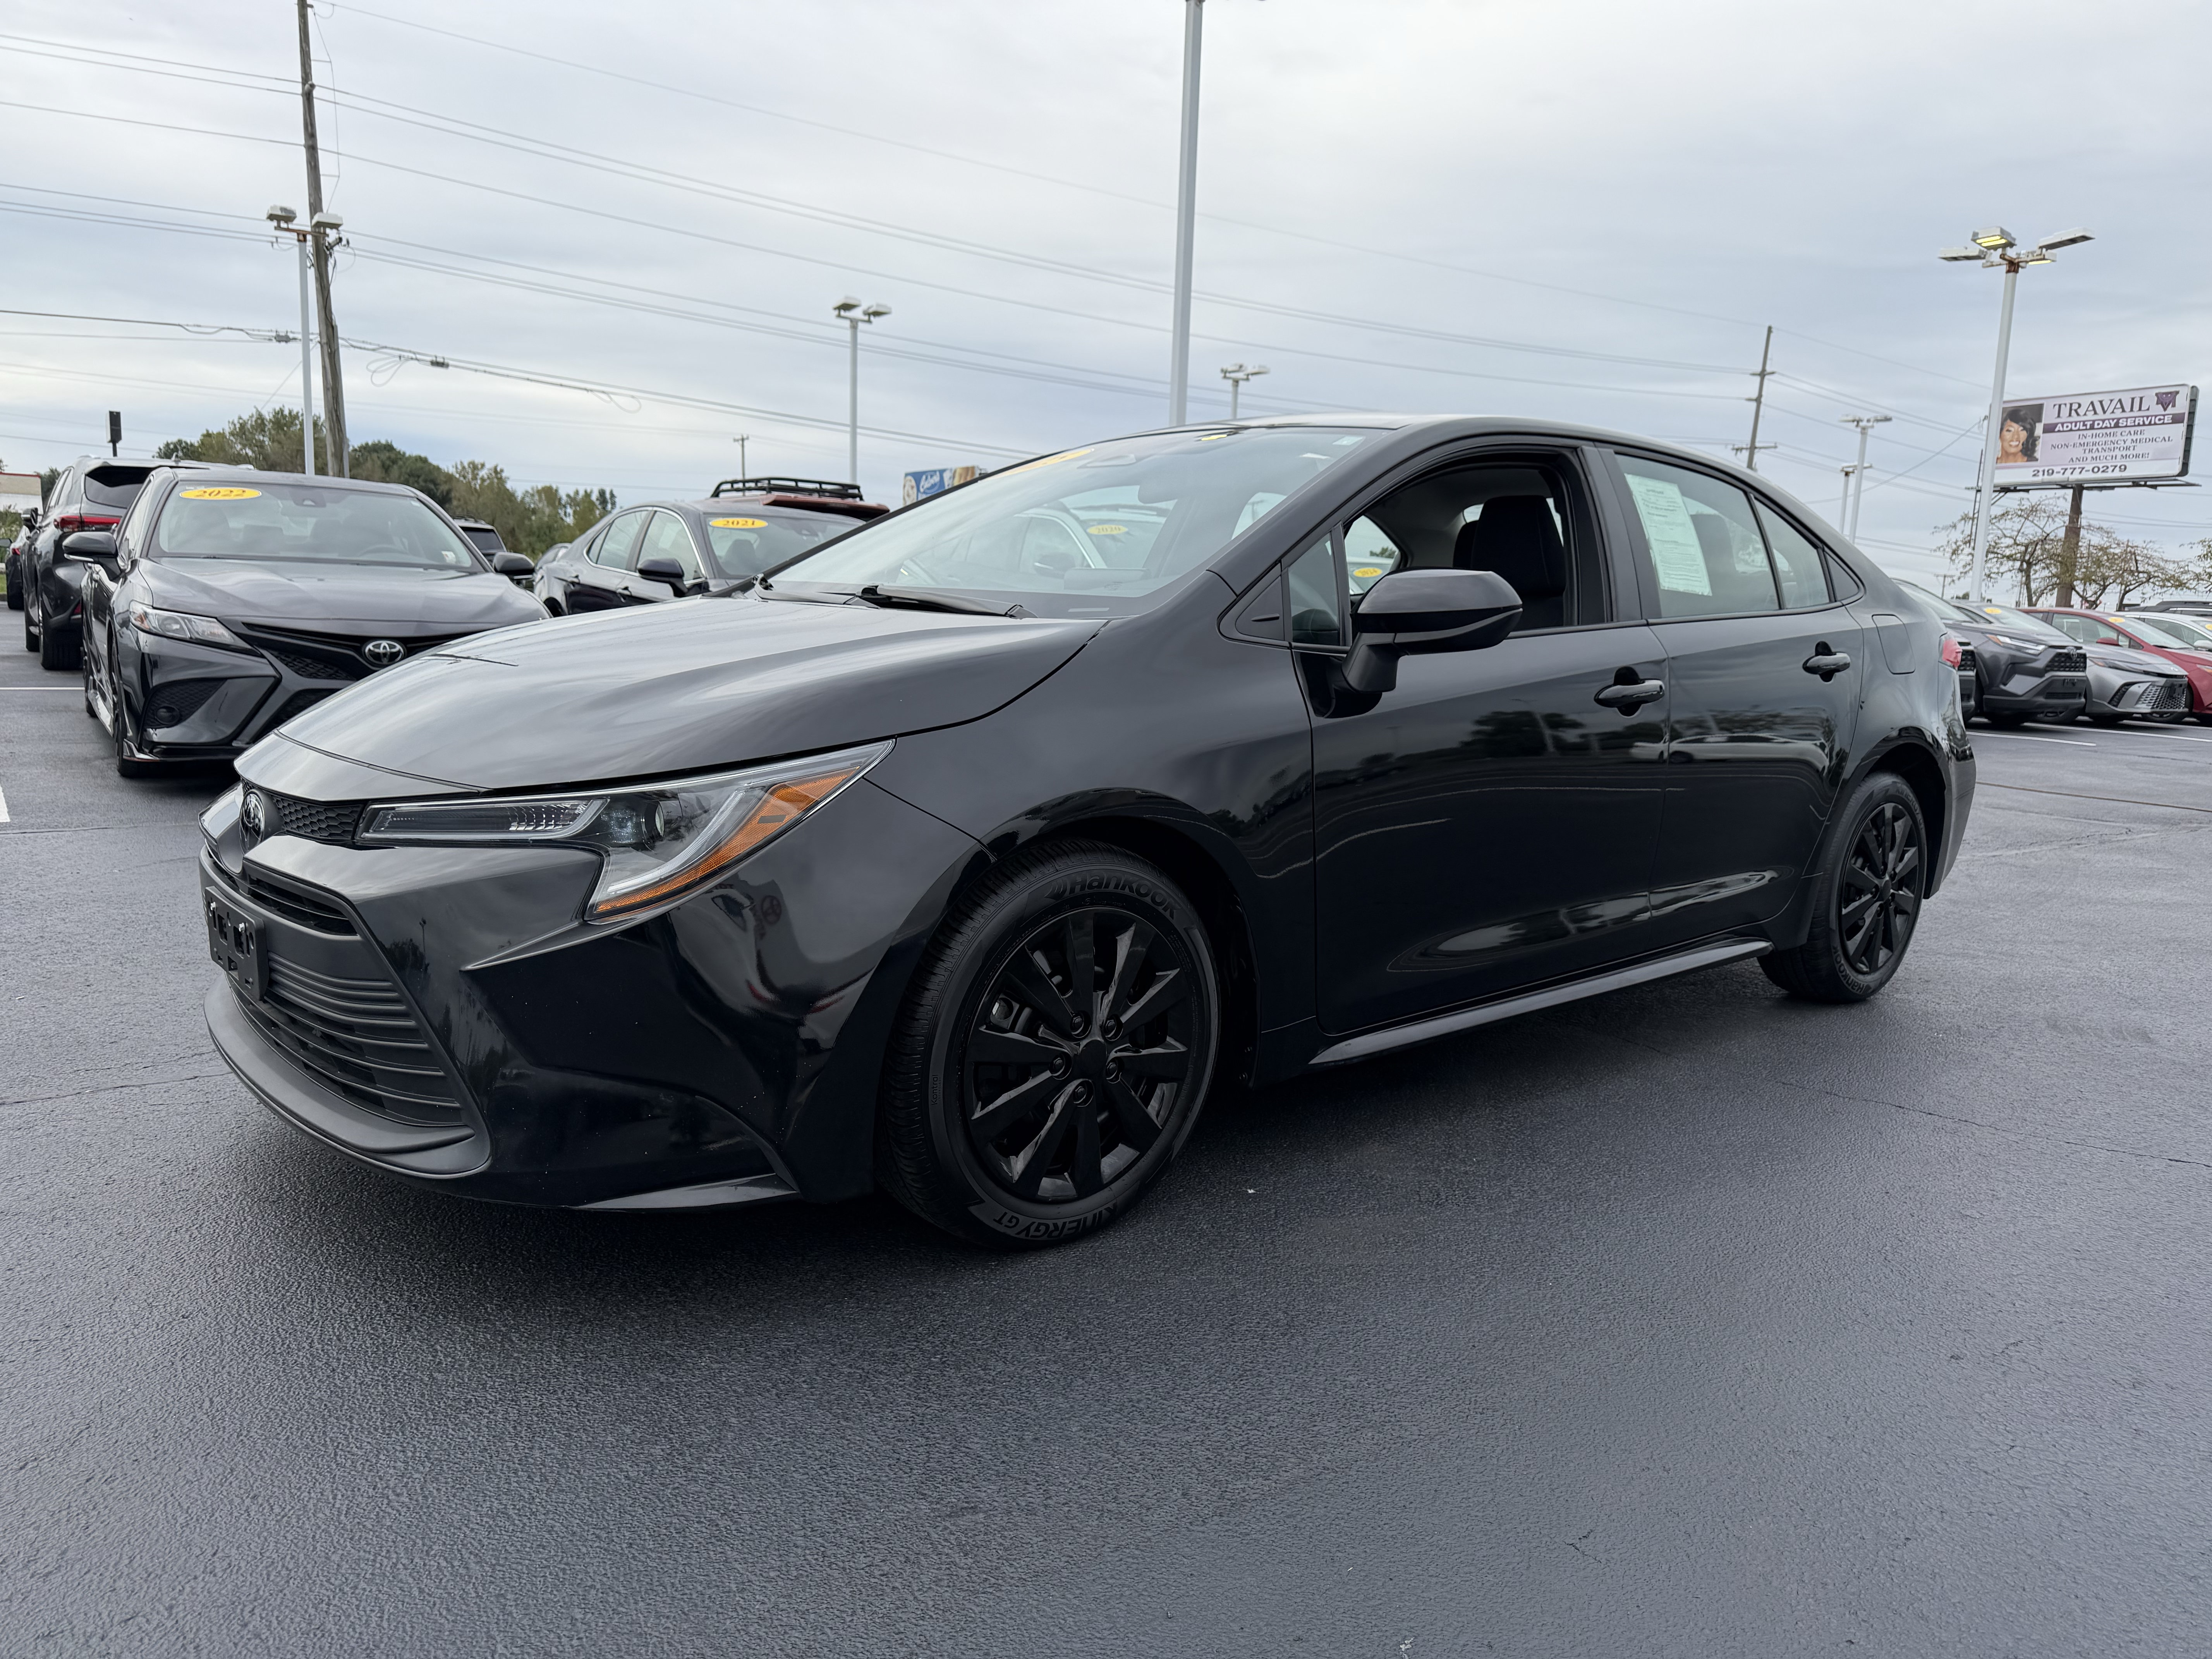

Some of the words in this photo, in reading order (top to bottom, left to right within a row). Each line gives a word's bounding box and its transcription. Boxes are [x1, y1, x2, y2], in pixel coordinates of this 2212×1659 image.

[2053, 396, 2150, 418] TRAVAIL
[2054, 421, 2093, 432] ADULT
[2094, 419, 2117, 428] DAY
[2118, 415, 2172, 427] SERVICE
[2078, 430, 2118, 440] IN-HOME
[2051, 439, 2128, 450] NON-EMERGENCY
[2131, 436, 2173, 445] MEDICAL
[2082, 445, 2137, 454] TRANSPORT
[2090, 454, 2118, 462] MUCH
[2032, 464, 2127, 477] 219-777-0279
[194, 489, 246, 498] 2022
[993, 1211, 1020, 1228] GT
